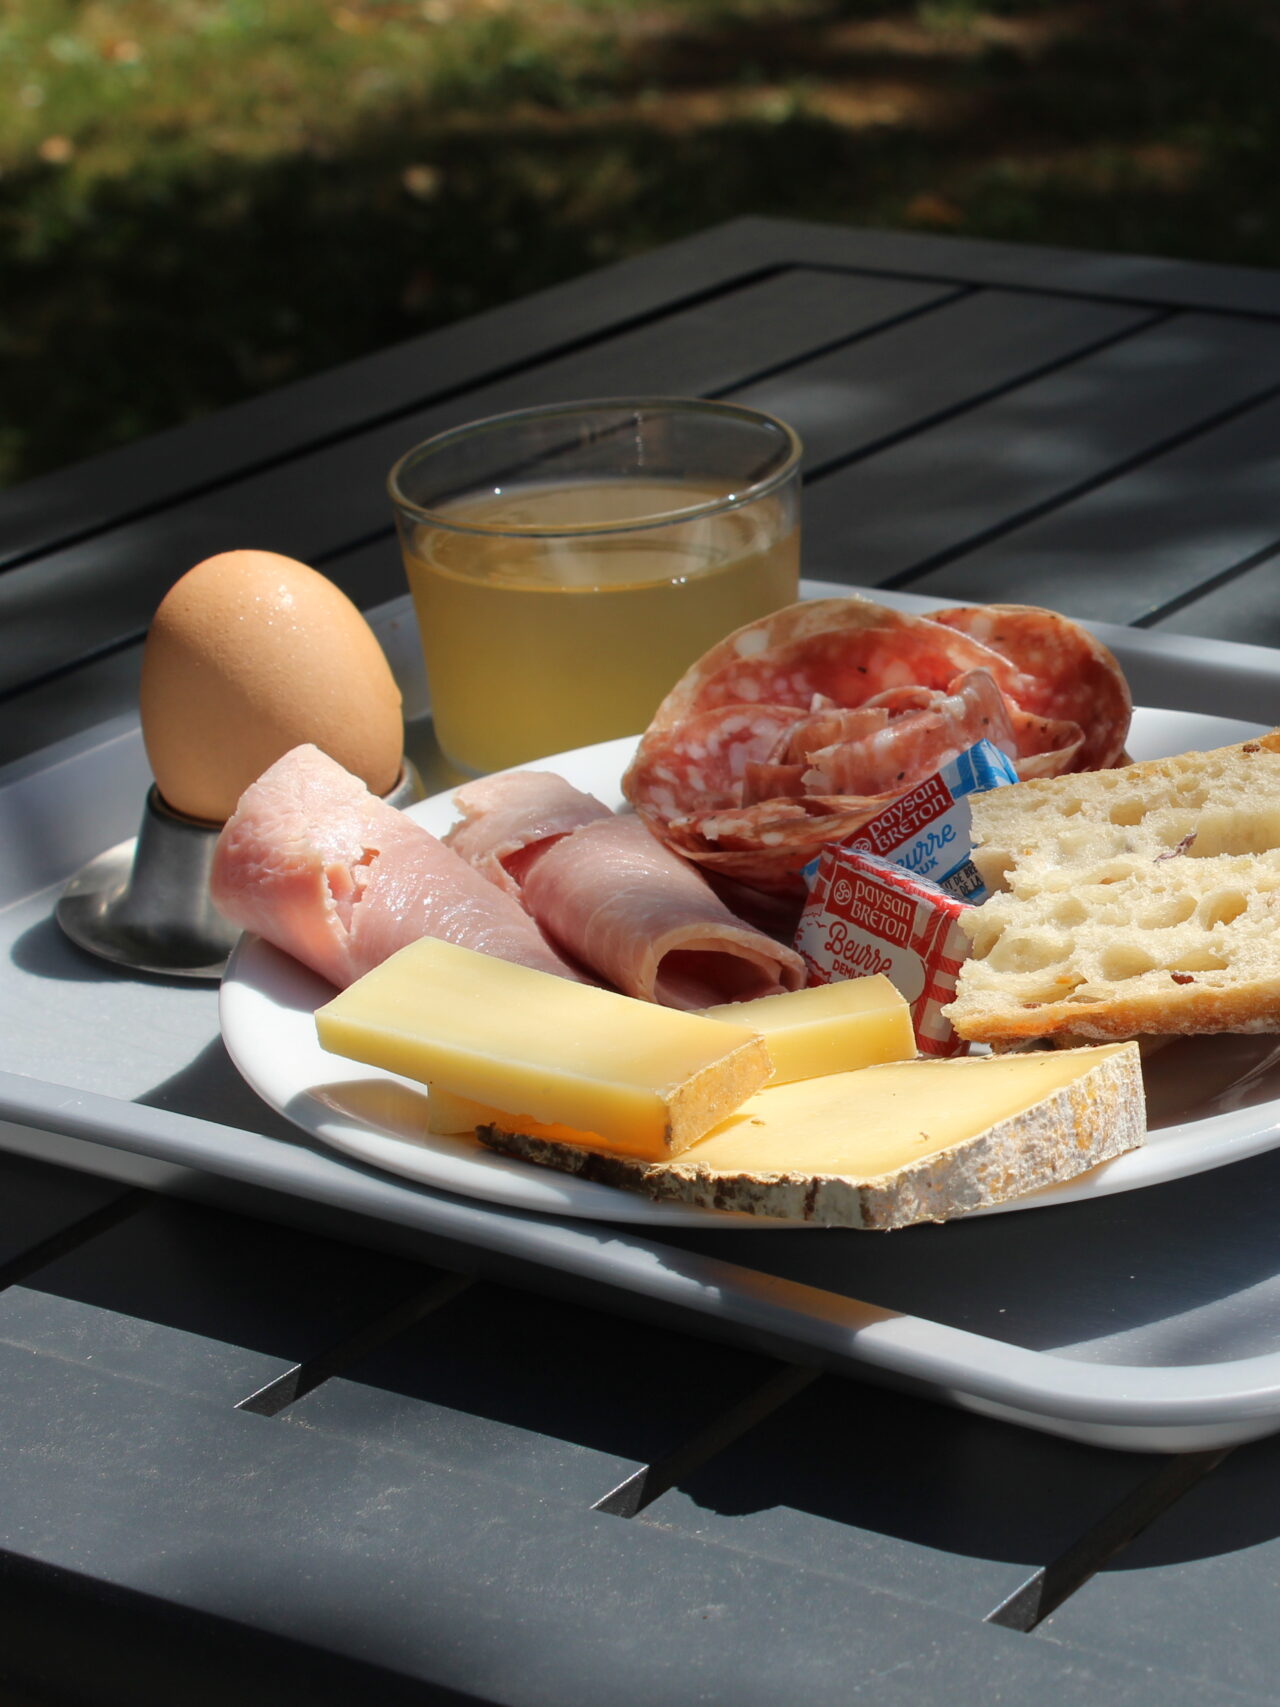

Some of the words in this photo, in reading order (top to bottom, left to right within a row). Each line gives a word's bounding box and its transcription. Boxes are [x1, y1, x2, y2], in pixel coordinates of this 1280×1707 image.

[875, 794, 947, 852] BRETON
[896, 824, 957, 870] eurre
[850, 900, 908, 941] BRETON
[824, 921, 893, 974] Beurre
